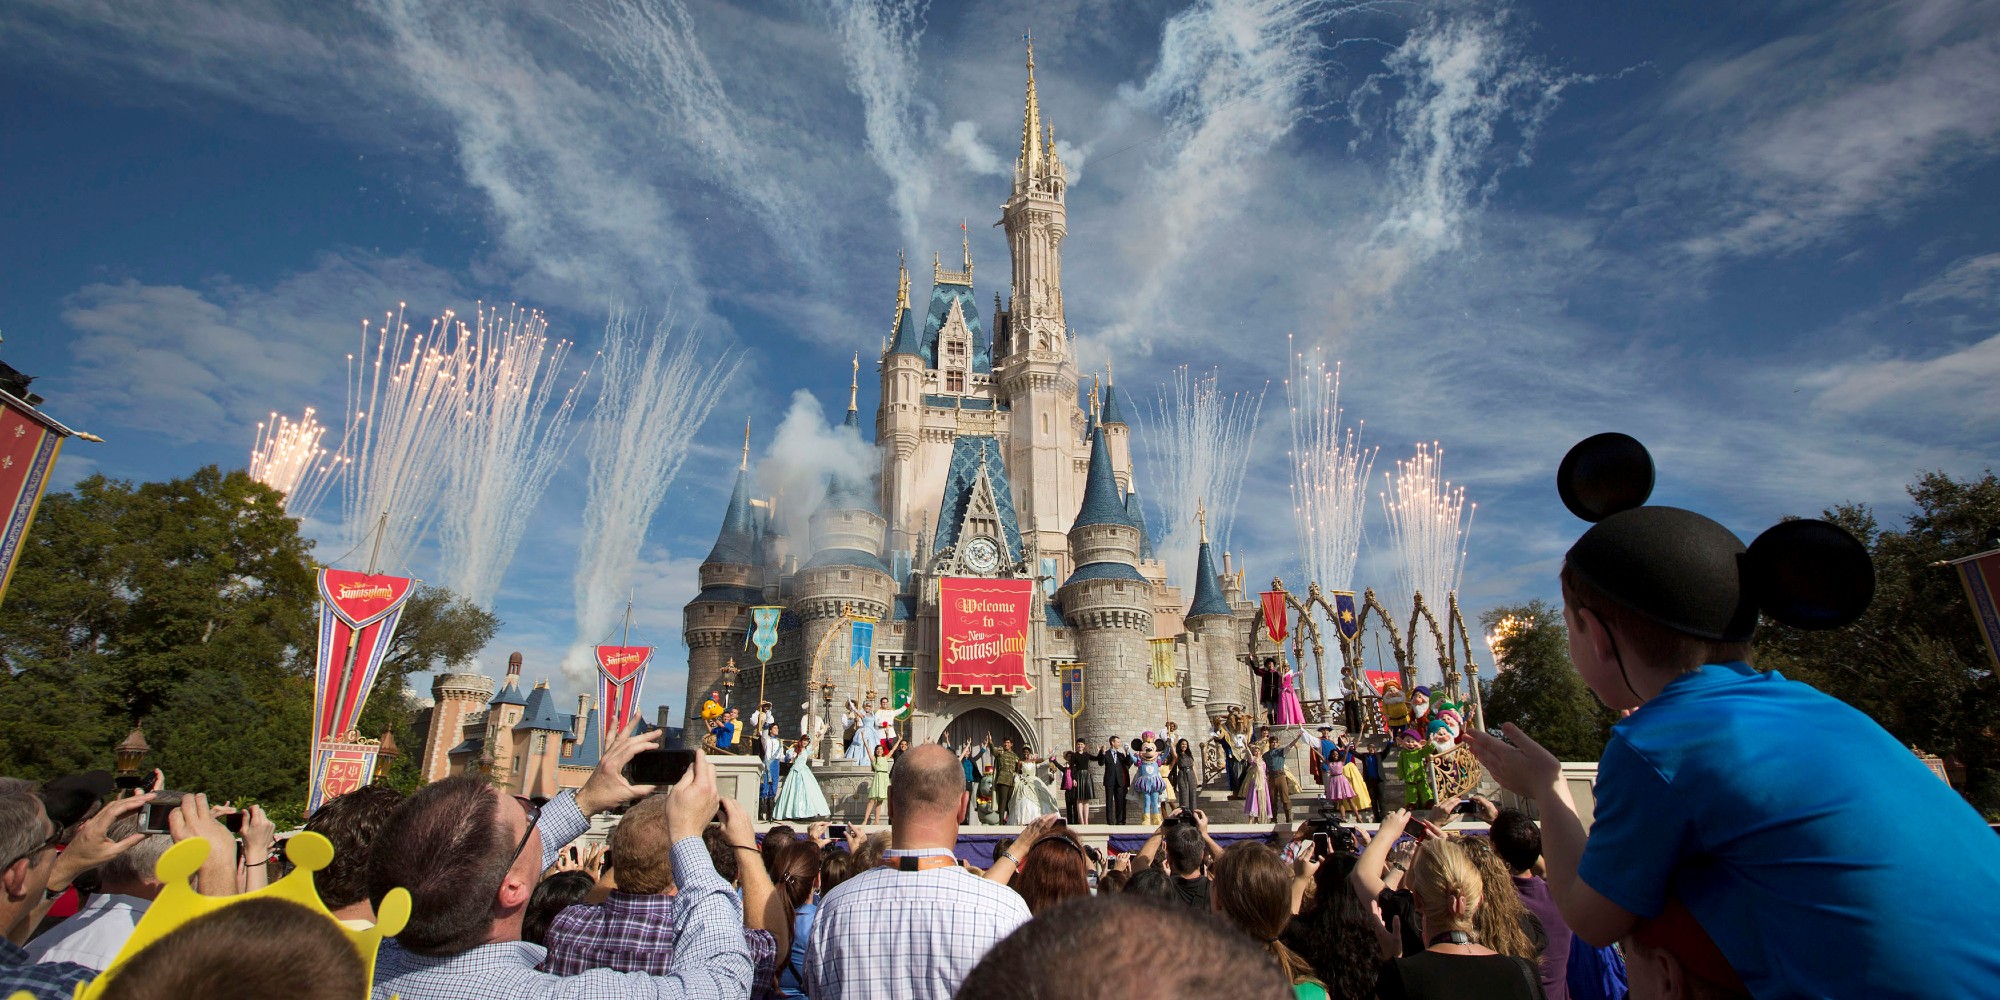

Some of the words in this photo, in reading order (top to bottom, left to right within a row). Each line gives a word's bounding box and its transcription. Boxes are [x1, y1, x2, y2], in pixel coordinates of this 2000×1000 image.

[957, 598, 1016, 614] Welcome
[982, 615, 995, 628] to
[968, 630, 985, 642] New
[946, 630, 1026, 665] Fantasyland
